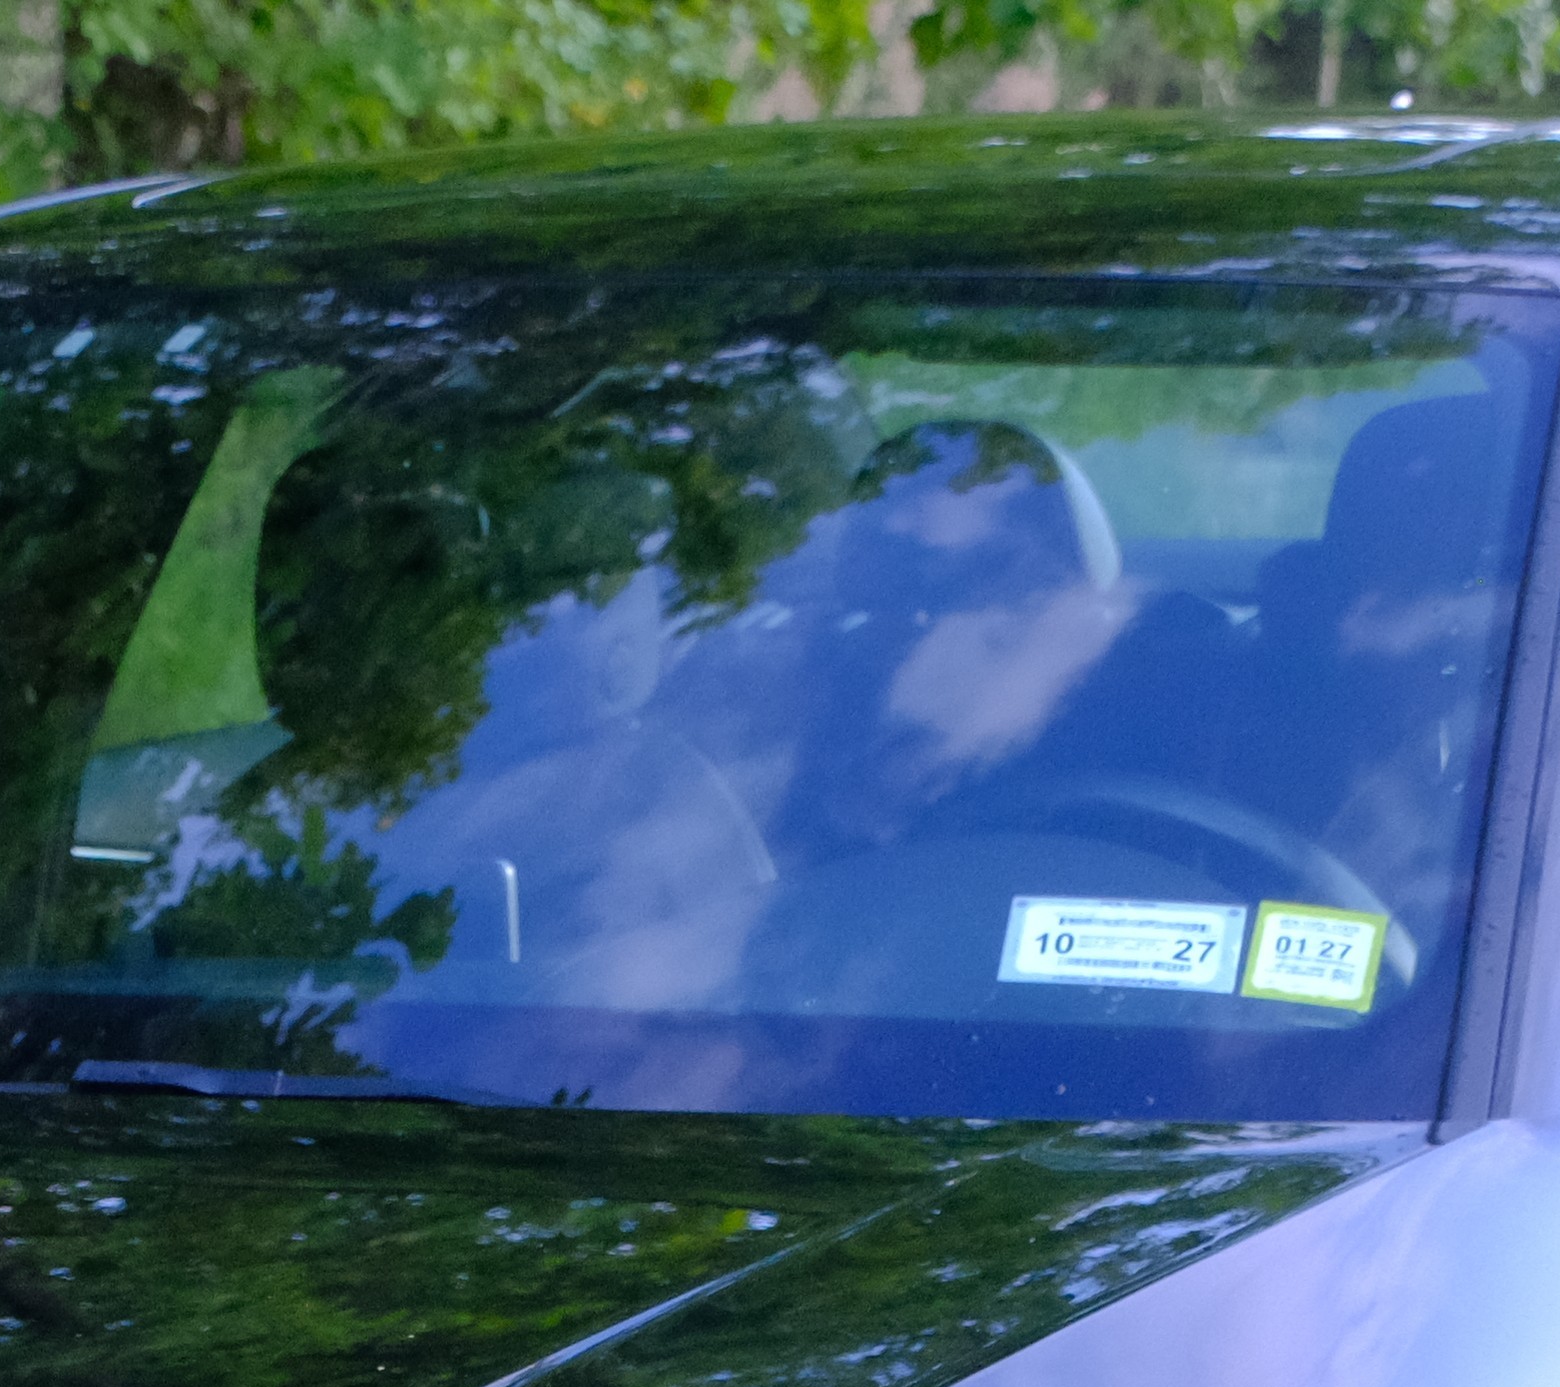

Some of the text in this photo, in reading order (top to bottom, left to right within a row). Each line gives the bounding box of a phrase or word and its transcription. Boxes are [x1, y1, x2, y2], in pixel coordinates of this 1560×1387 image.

[1034, 932, 1075, 956] 10
[1171, 939, 1218, 964] 27
[1275, 935, 1354, 960] 01 27
